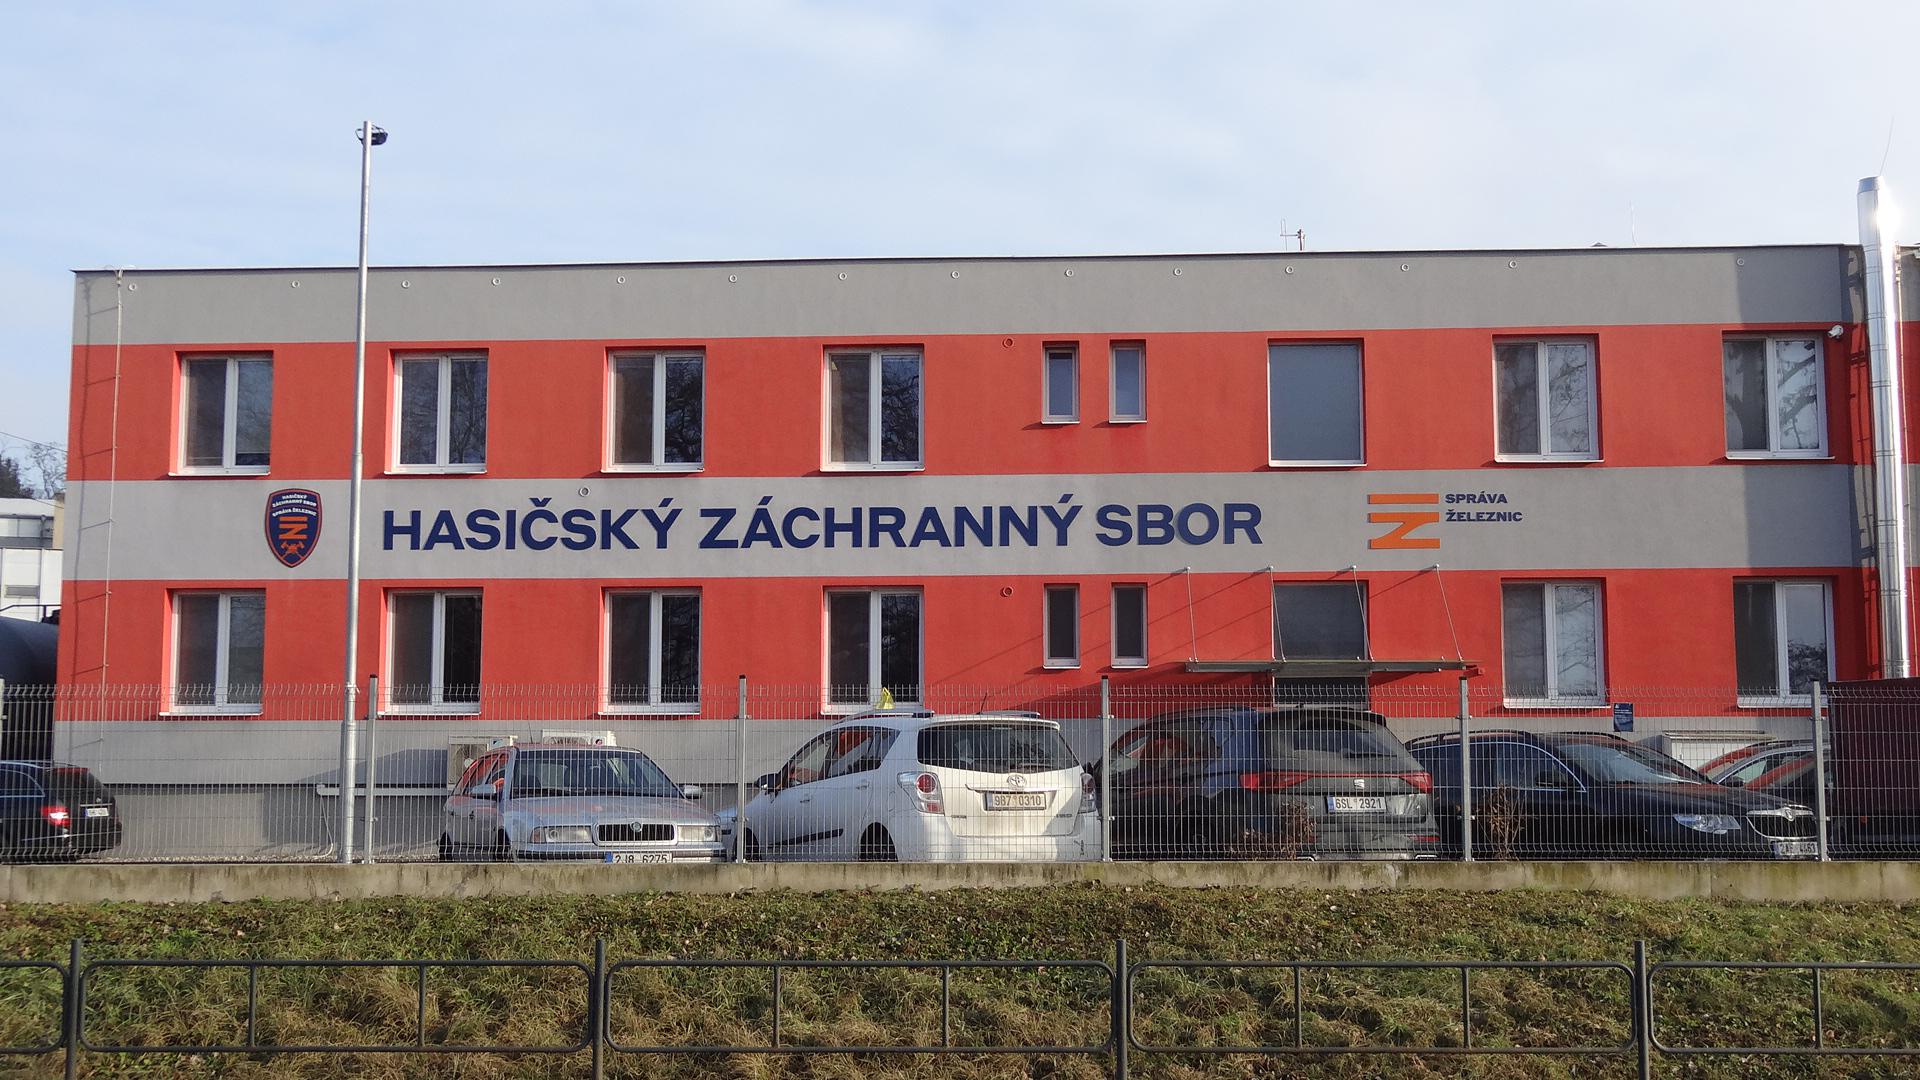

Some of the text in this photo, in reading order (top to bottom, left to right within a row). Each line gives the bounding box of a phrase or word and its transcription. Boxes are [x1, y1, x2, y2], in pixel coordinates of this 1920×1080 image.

[1445, 491, 1508, 504] SPRÁVA
[1445, 509, 1523, 522] ŽELEZNIC
[383, 494, 1263, 550] HASIČSKÝ ZÁCHRANNÝ SBOR
[1018, 795, 1042, 806] 0310
[1335, 798, 1382, 809] 6SL 2921
[642, 854, 667, 863] 6275
